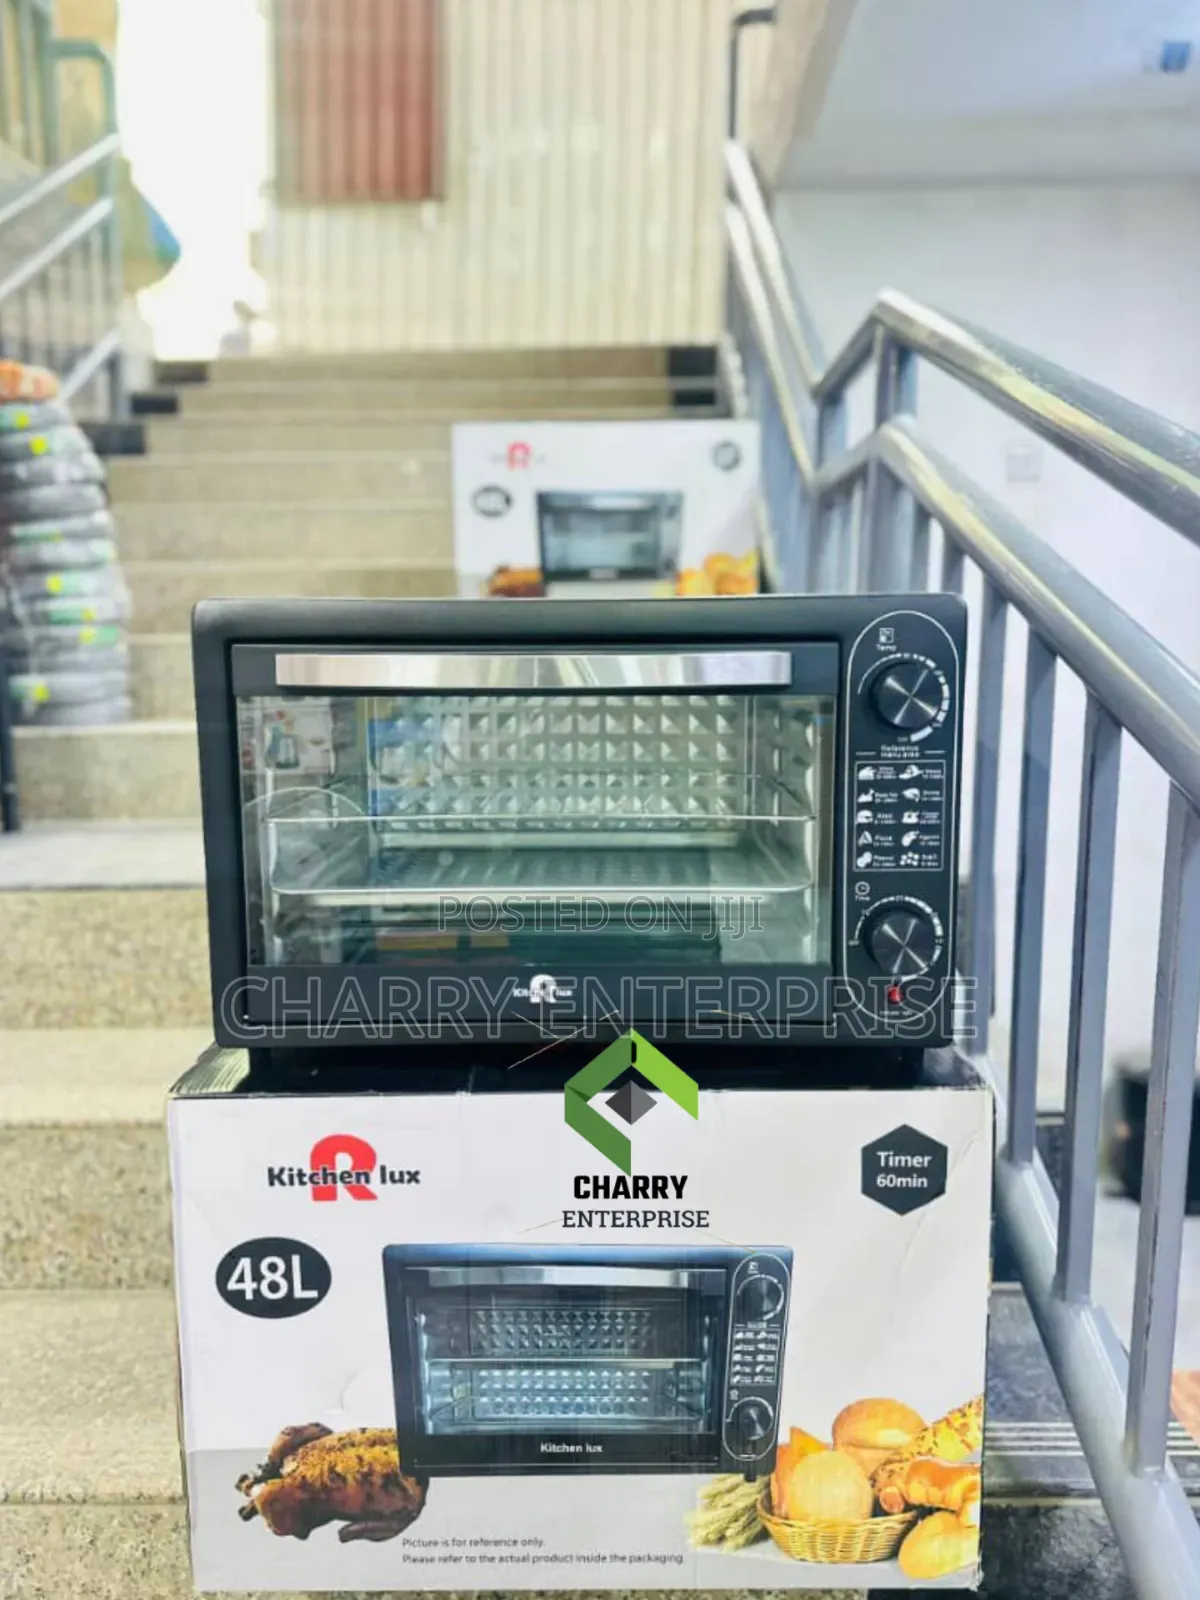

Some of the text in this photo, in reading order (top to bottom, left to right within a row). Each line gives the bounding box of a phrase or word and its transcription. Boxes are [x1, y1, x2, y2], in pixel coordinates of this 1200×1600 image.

[876, 1151, 932, 1168] Timer
[267, 1164, 421, 1187] Kitchen lux
[876, 1173, 928, 1188] 60min
[226, 1254, 319, 1301] 48L
[540, 1442, 603, 1452] Kitchen lux
[402, 1538, 440, 1548] Picture
[441, 1538, 450, 1547] is
[452, 1537, 467, 1547] for
[469, 1537, 518, 1547] reference
[402, 1554, 436, 1564] Please
[438, 1554, 463, 1563] refer
[465, 1555, 477, 1563] to
[479, 1554, 496, 1563] the
[498, 1553, 529, 1563] actual
[532, 1554, 573, 1565] product
[576, 1553, 607, 1563] inside
[609, 1554, 627, 1563] the
